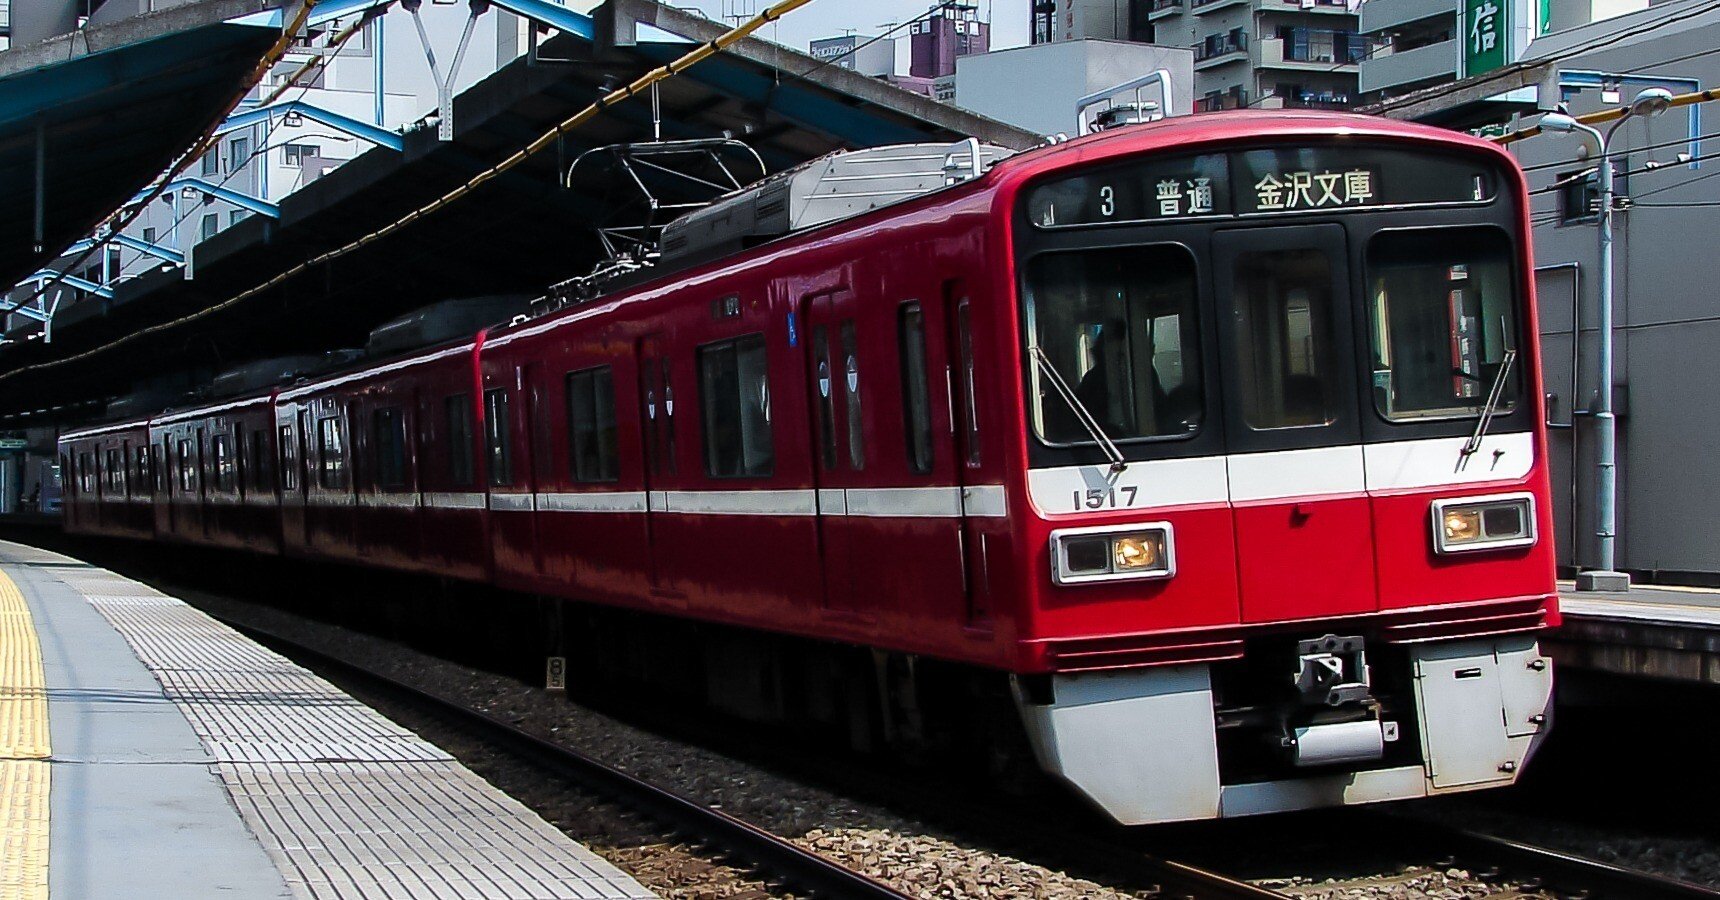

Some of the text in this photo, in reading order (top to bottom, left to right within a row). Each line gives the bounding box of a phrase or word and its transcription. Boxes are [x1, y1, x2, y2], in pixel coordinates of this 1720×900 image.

[1470, 0, 1498, 54] 信
[1100, 169, 1373, 216] 3 普通 金沢文庫
[1074, 486, 1138, 510] 1517
